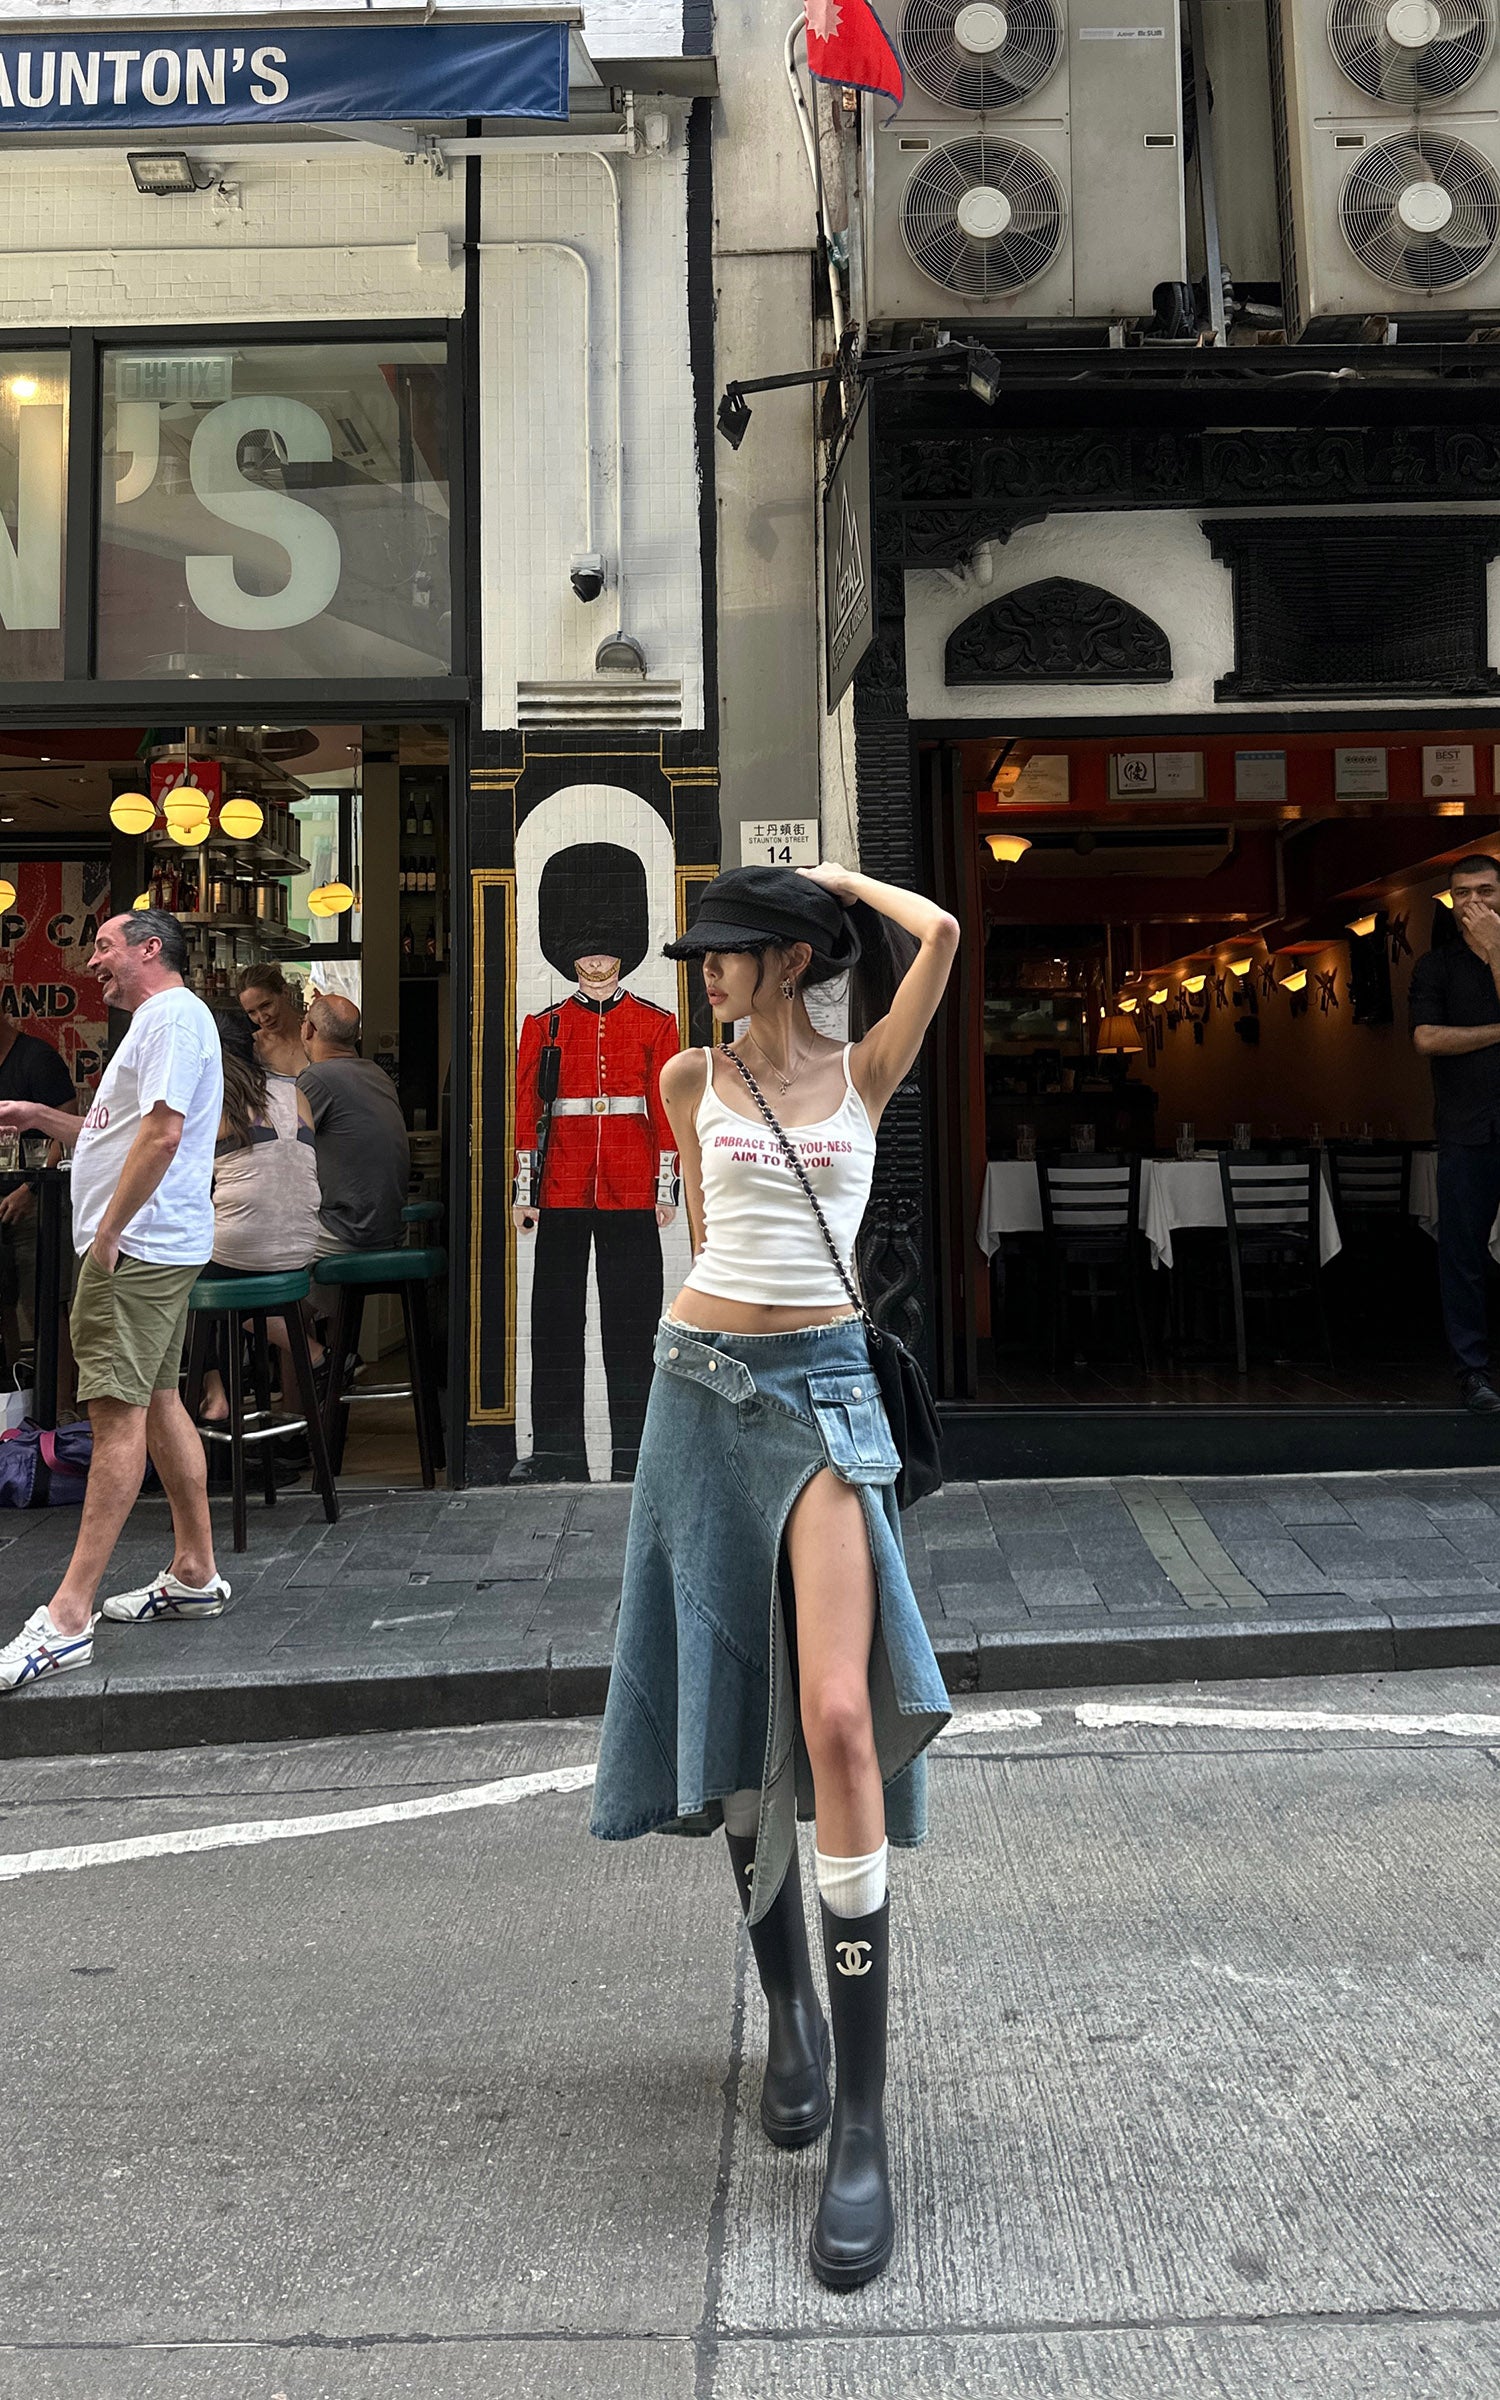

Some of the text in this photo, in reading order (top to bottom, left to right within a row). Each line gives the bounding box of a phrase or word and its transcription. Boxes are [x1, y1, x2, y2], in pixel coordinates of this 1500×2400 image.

[1435, 751, 1460, 760] BEST
[754, 824, 805, 836] 士丹頓街
[767, 845, 792, 864] 14
[714, 1136, 852, 1154] EMBRACE TH YOU-NESS
[732, 1151, 757, 1162] AIM
[762, 1154, 780, 1166] TO
[803, 1157, 834, 1168] YOU.
